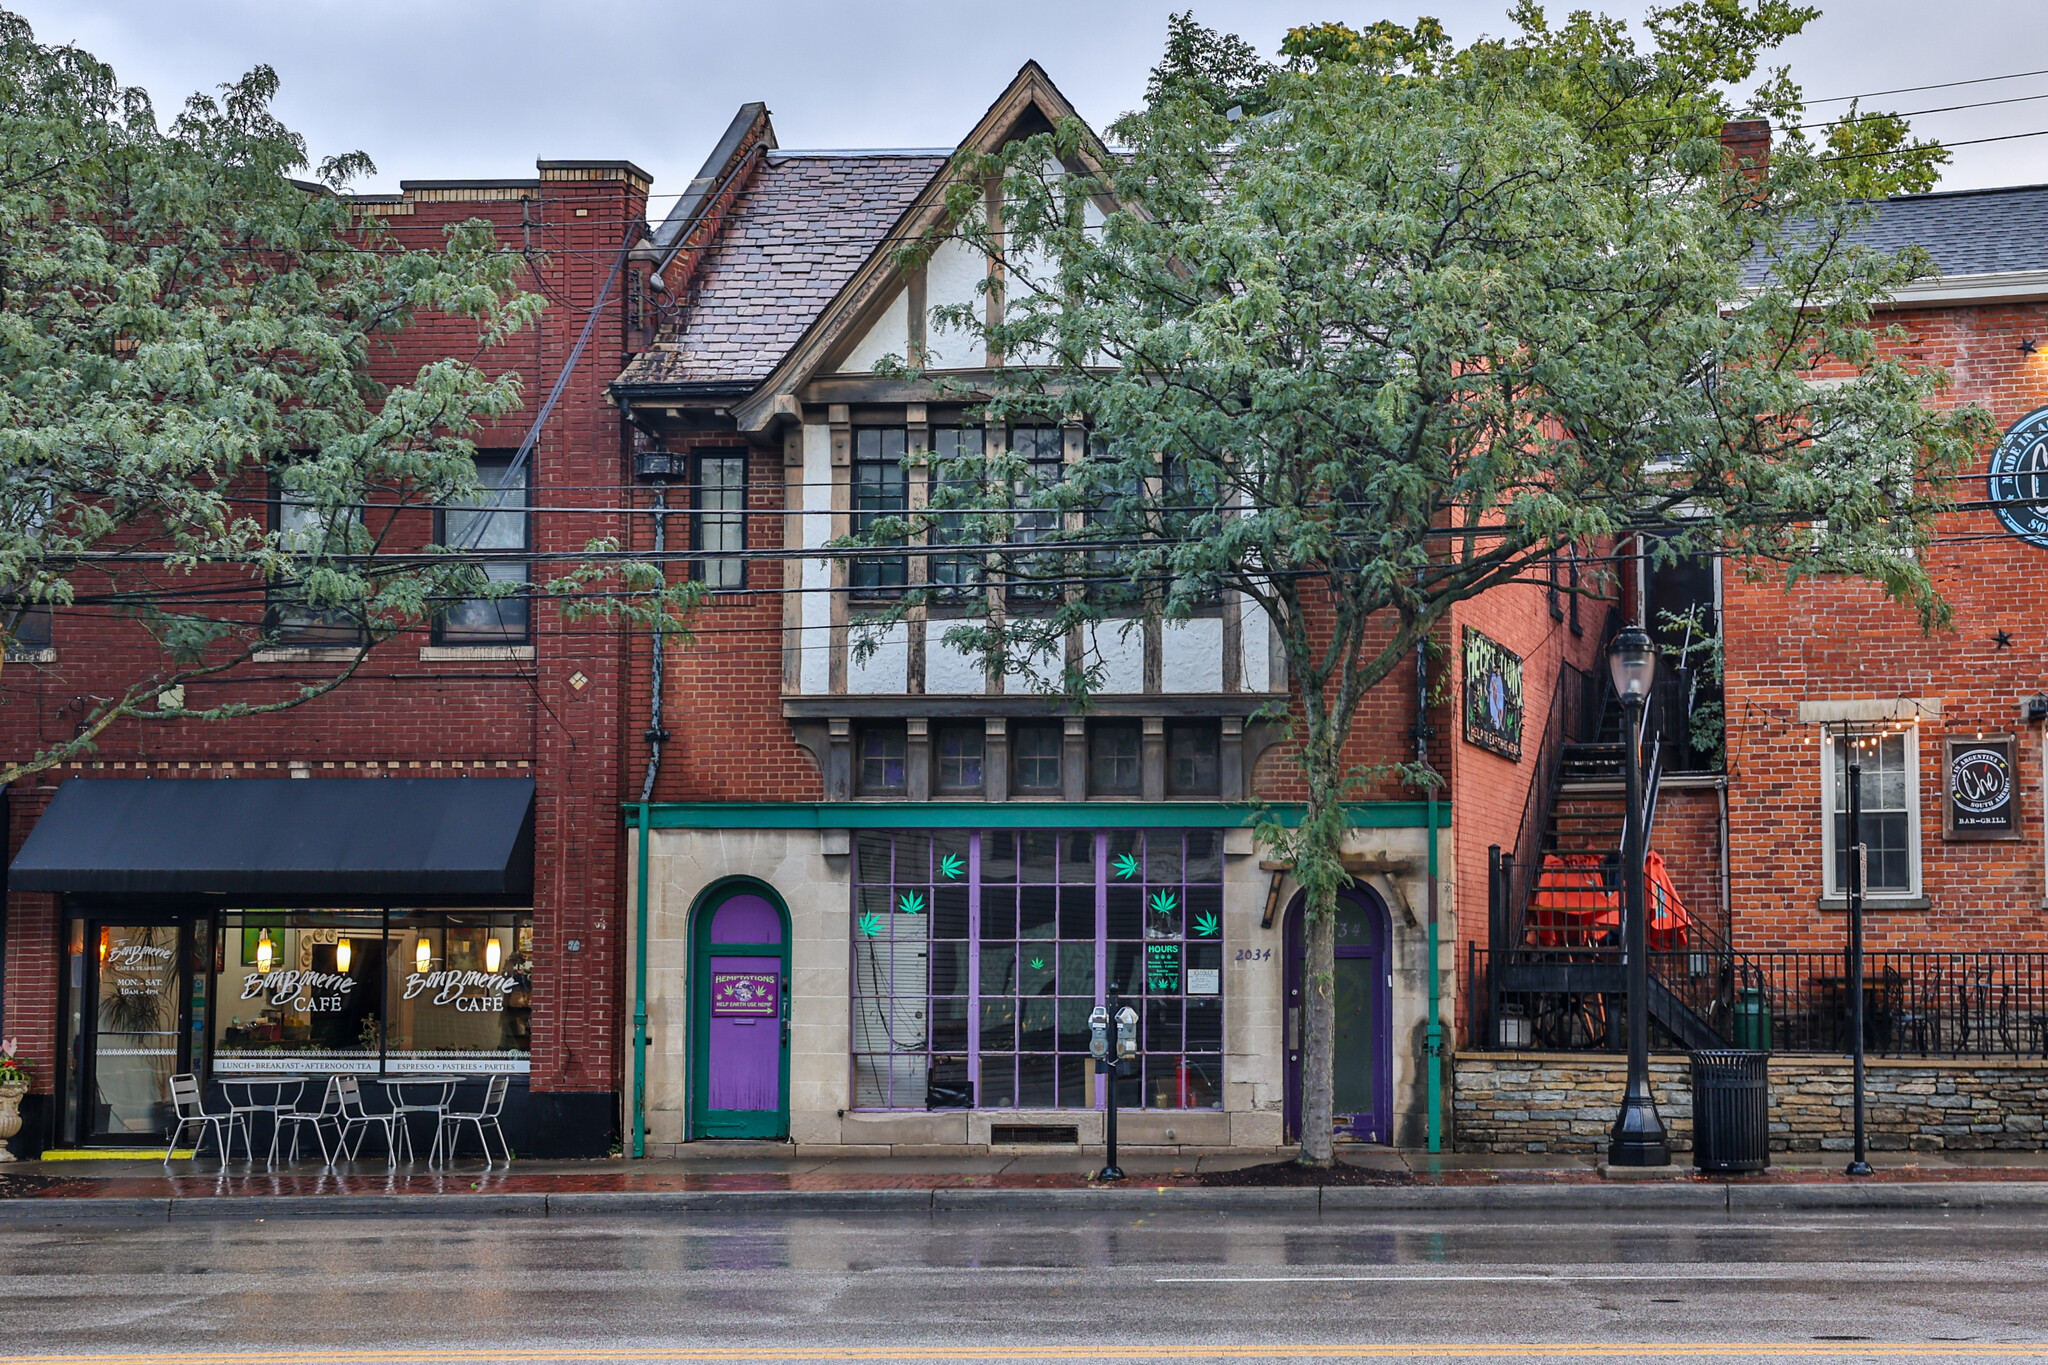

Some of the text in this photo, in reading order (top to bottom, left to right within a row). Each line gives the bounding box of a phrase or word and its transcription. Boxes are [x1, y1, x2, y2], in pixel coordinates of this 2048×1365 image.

[2002, 430, 2035, 485] MADE IN
[2028, 518, 2048, 534] SO
[1466, 637, 1523, 708] HEMPTTIONS
[1960, 754, 1998, 767] ARGENTINA
[1962, 763, 1998, 800] Ché
[1995, 778, 2010, 803] AMERICA
[1148, 945, 1179, 953] HOURS
[1235, 948, 1271, 961] 2034
[715, 975, 775, 983] HEMPTATIONS
[294, 993, 342, 1012] CAFÉ
[456, 993, 504, 1012] CAFÉ
